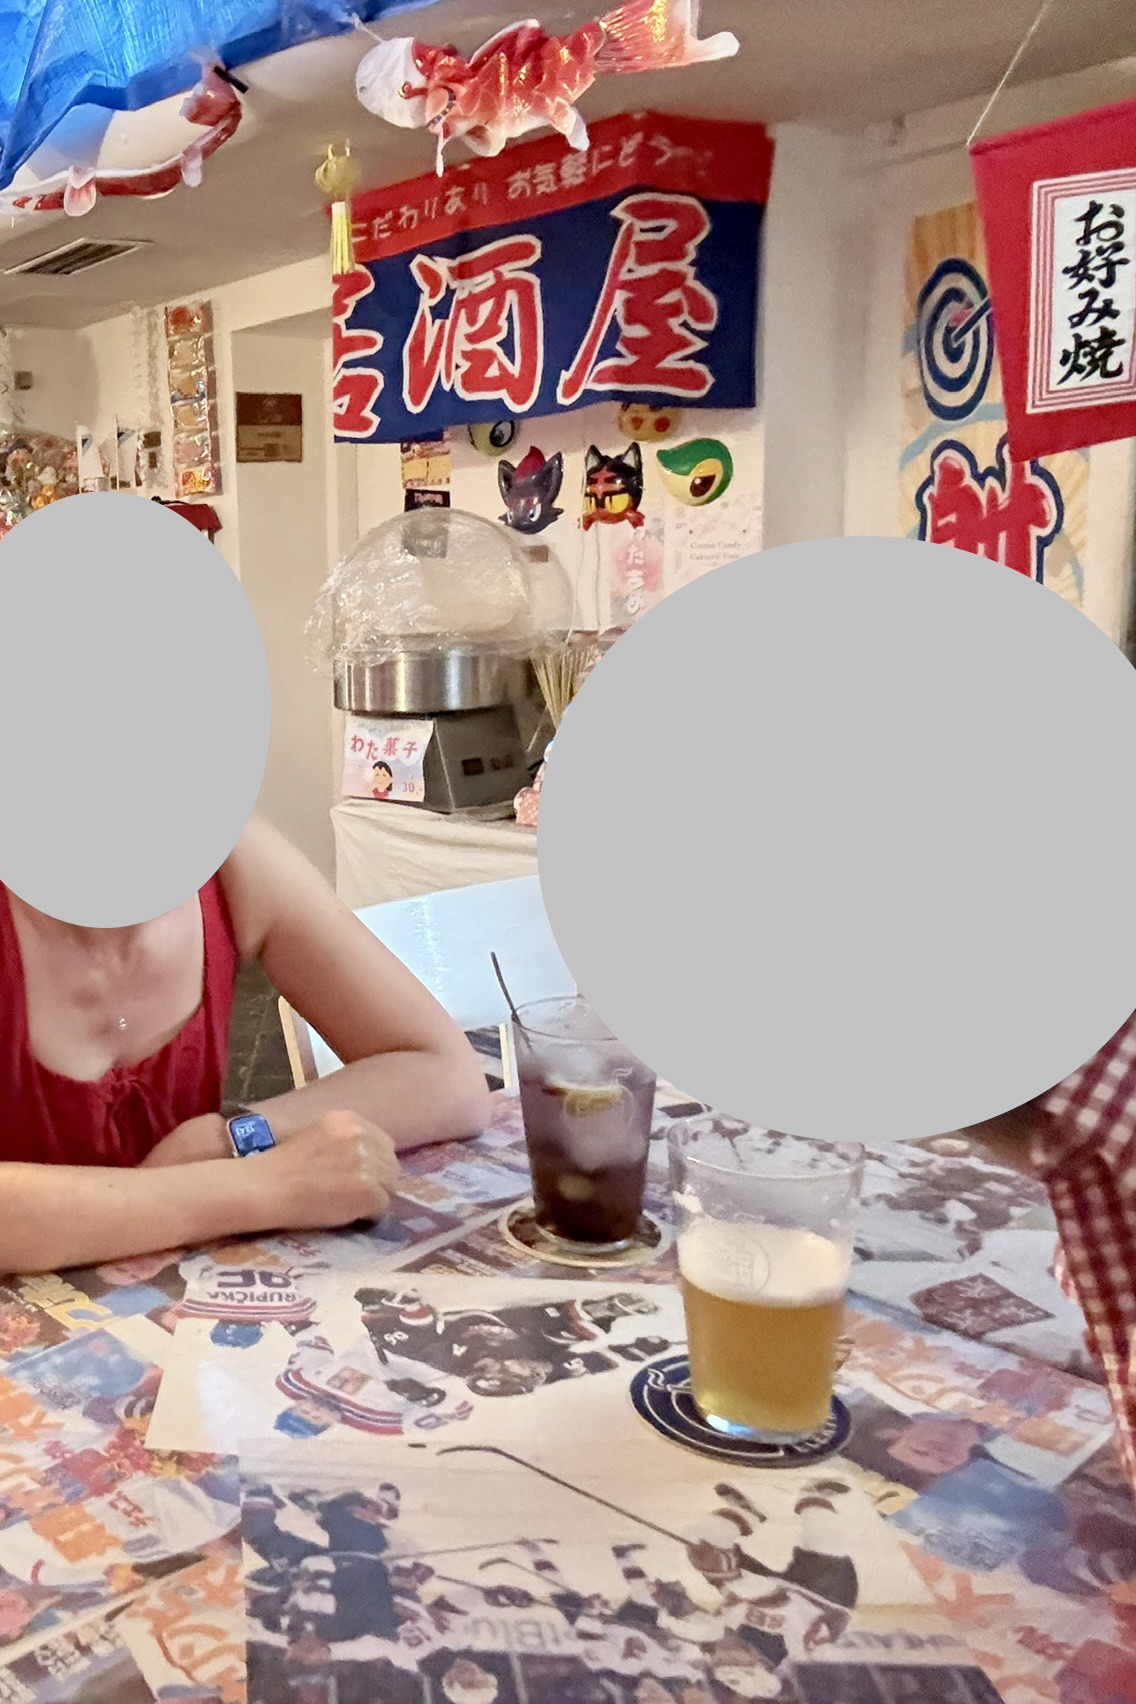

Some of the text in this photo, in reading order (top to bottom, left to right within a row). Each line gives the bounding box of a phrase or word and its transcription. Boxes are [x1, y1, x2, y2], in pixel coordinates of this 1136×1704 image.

[1055, 199, 1130, 386] お好み焼
[351, 734, 418, 761] わた菓子
